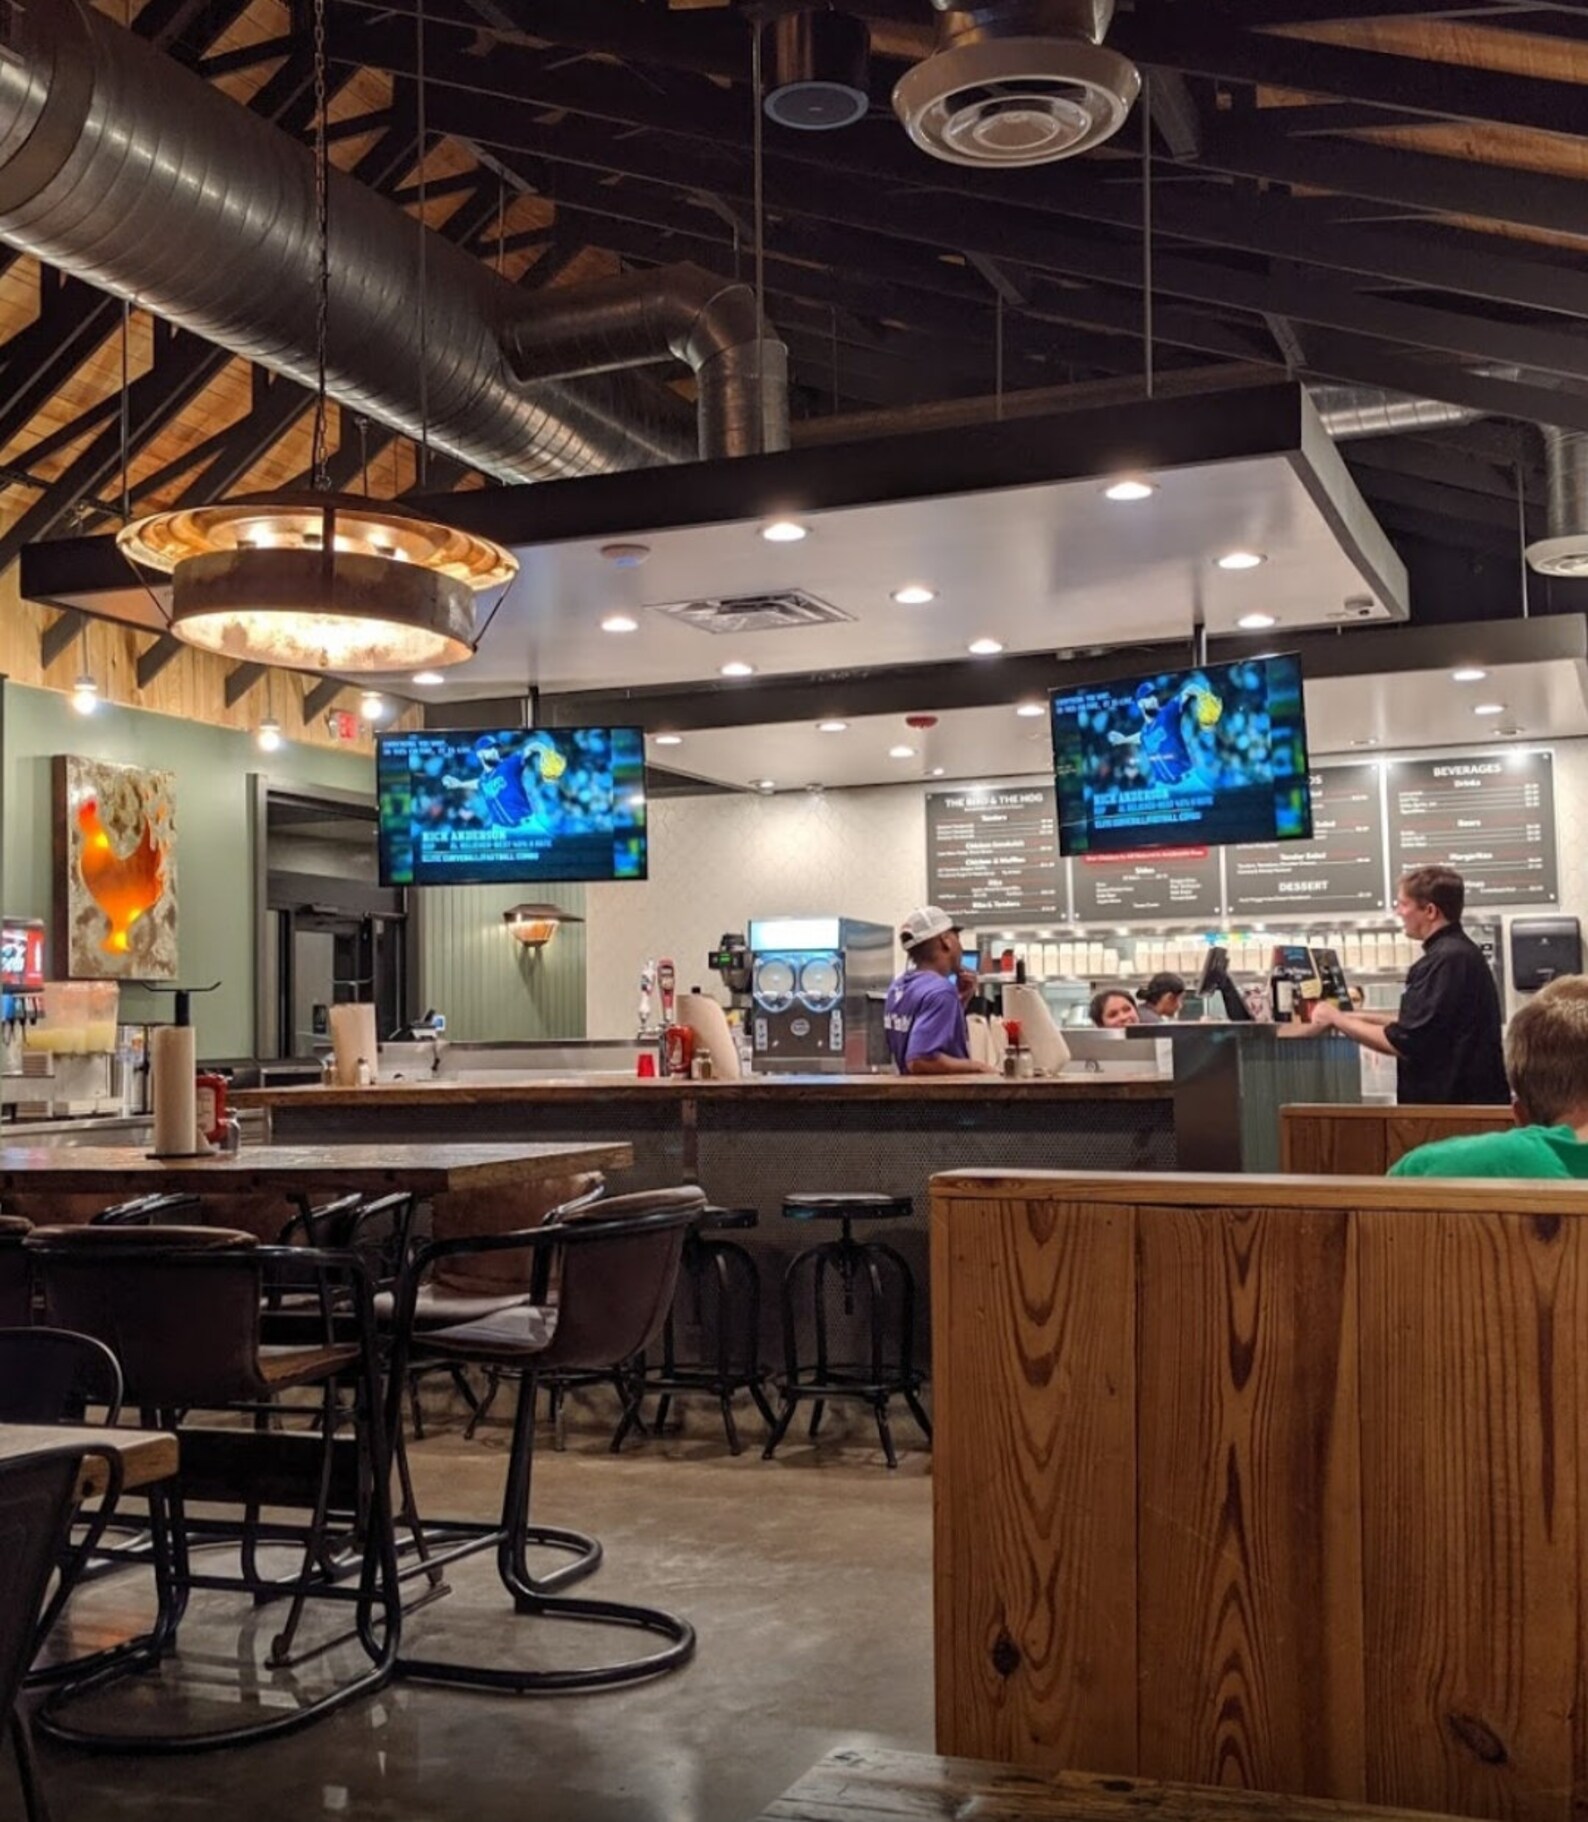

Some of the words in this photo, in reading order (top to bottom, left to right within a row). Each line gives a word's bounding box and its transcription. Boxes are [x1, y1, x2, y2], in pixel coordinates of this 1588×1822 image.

[1433, 763, 1502, 777] BEVERAGES
[945, 798, 965, 808] THE
[999, 795, 1019, 805] THE
[1278, 880, 1329, 892] DESSERT
